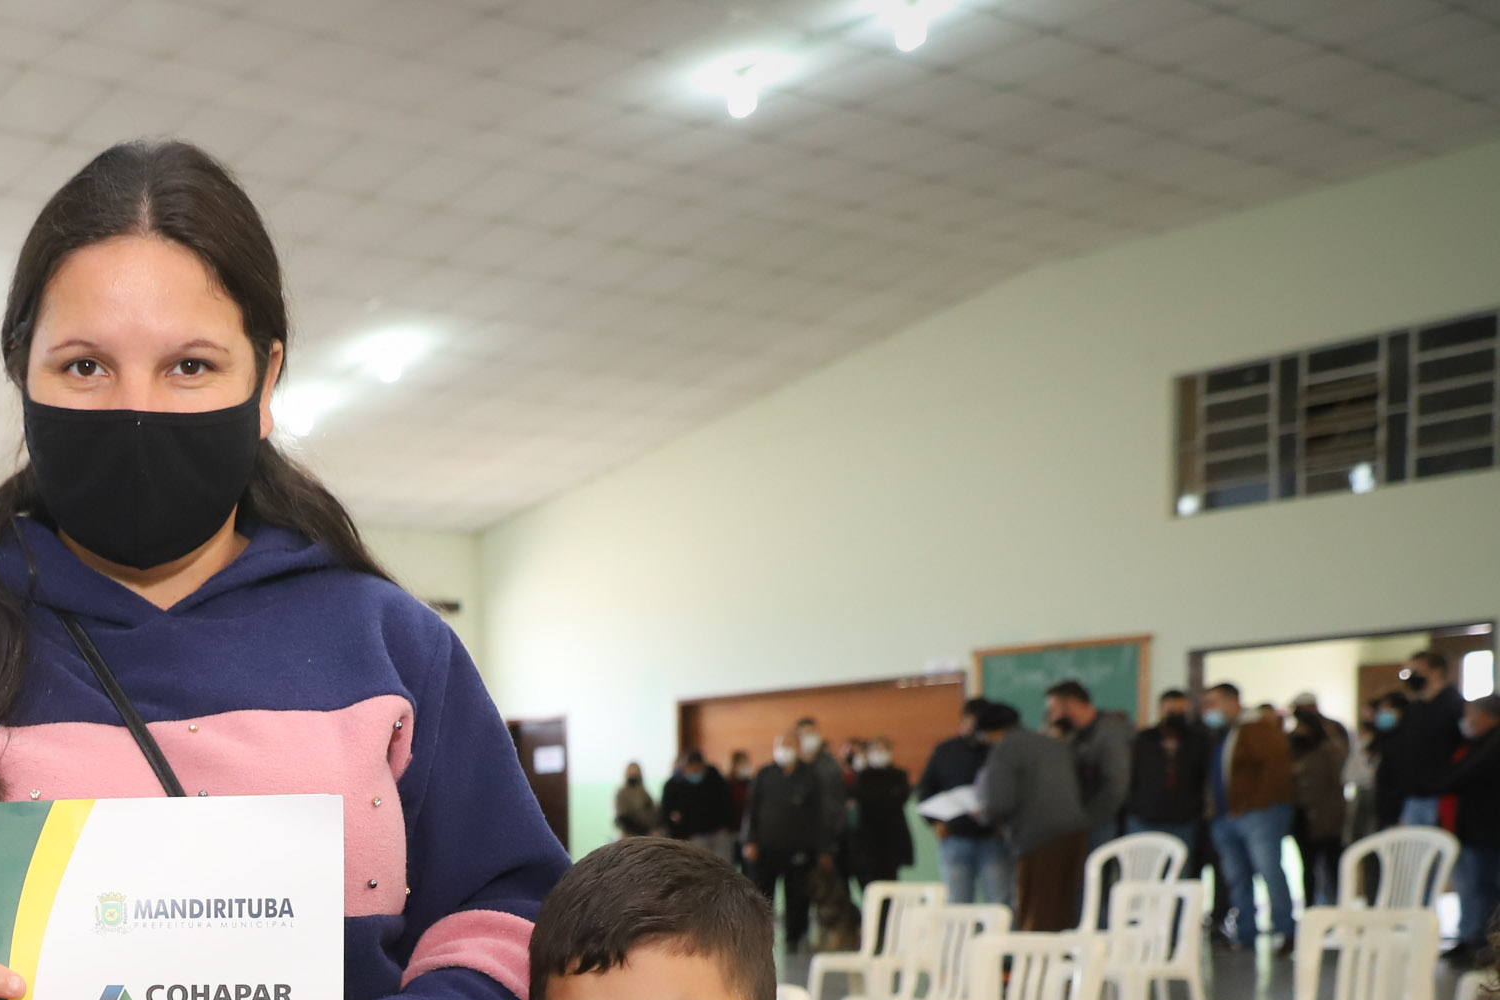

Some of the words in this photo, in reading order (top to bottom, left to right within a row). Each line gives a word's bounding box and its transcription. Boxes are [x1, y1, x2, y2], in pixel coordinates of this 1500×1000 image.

[134, 898, 295, 919] MANDIRITUBA
[134, 921, 213, 929] PREFEITURA
[220, 921, 295, 929] MUNICIPAL
